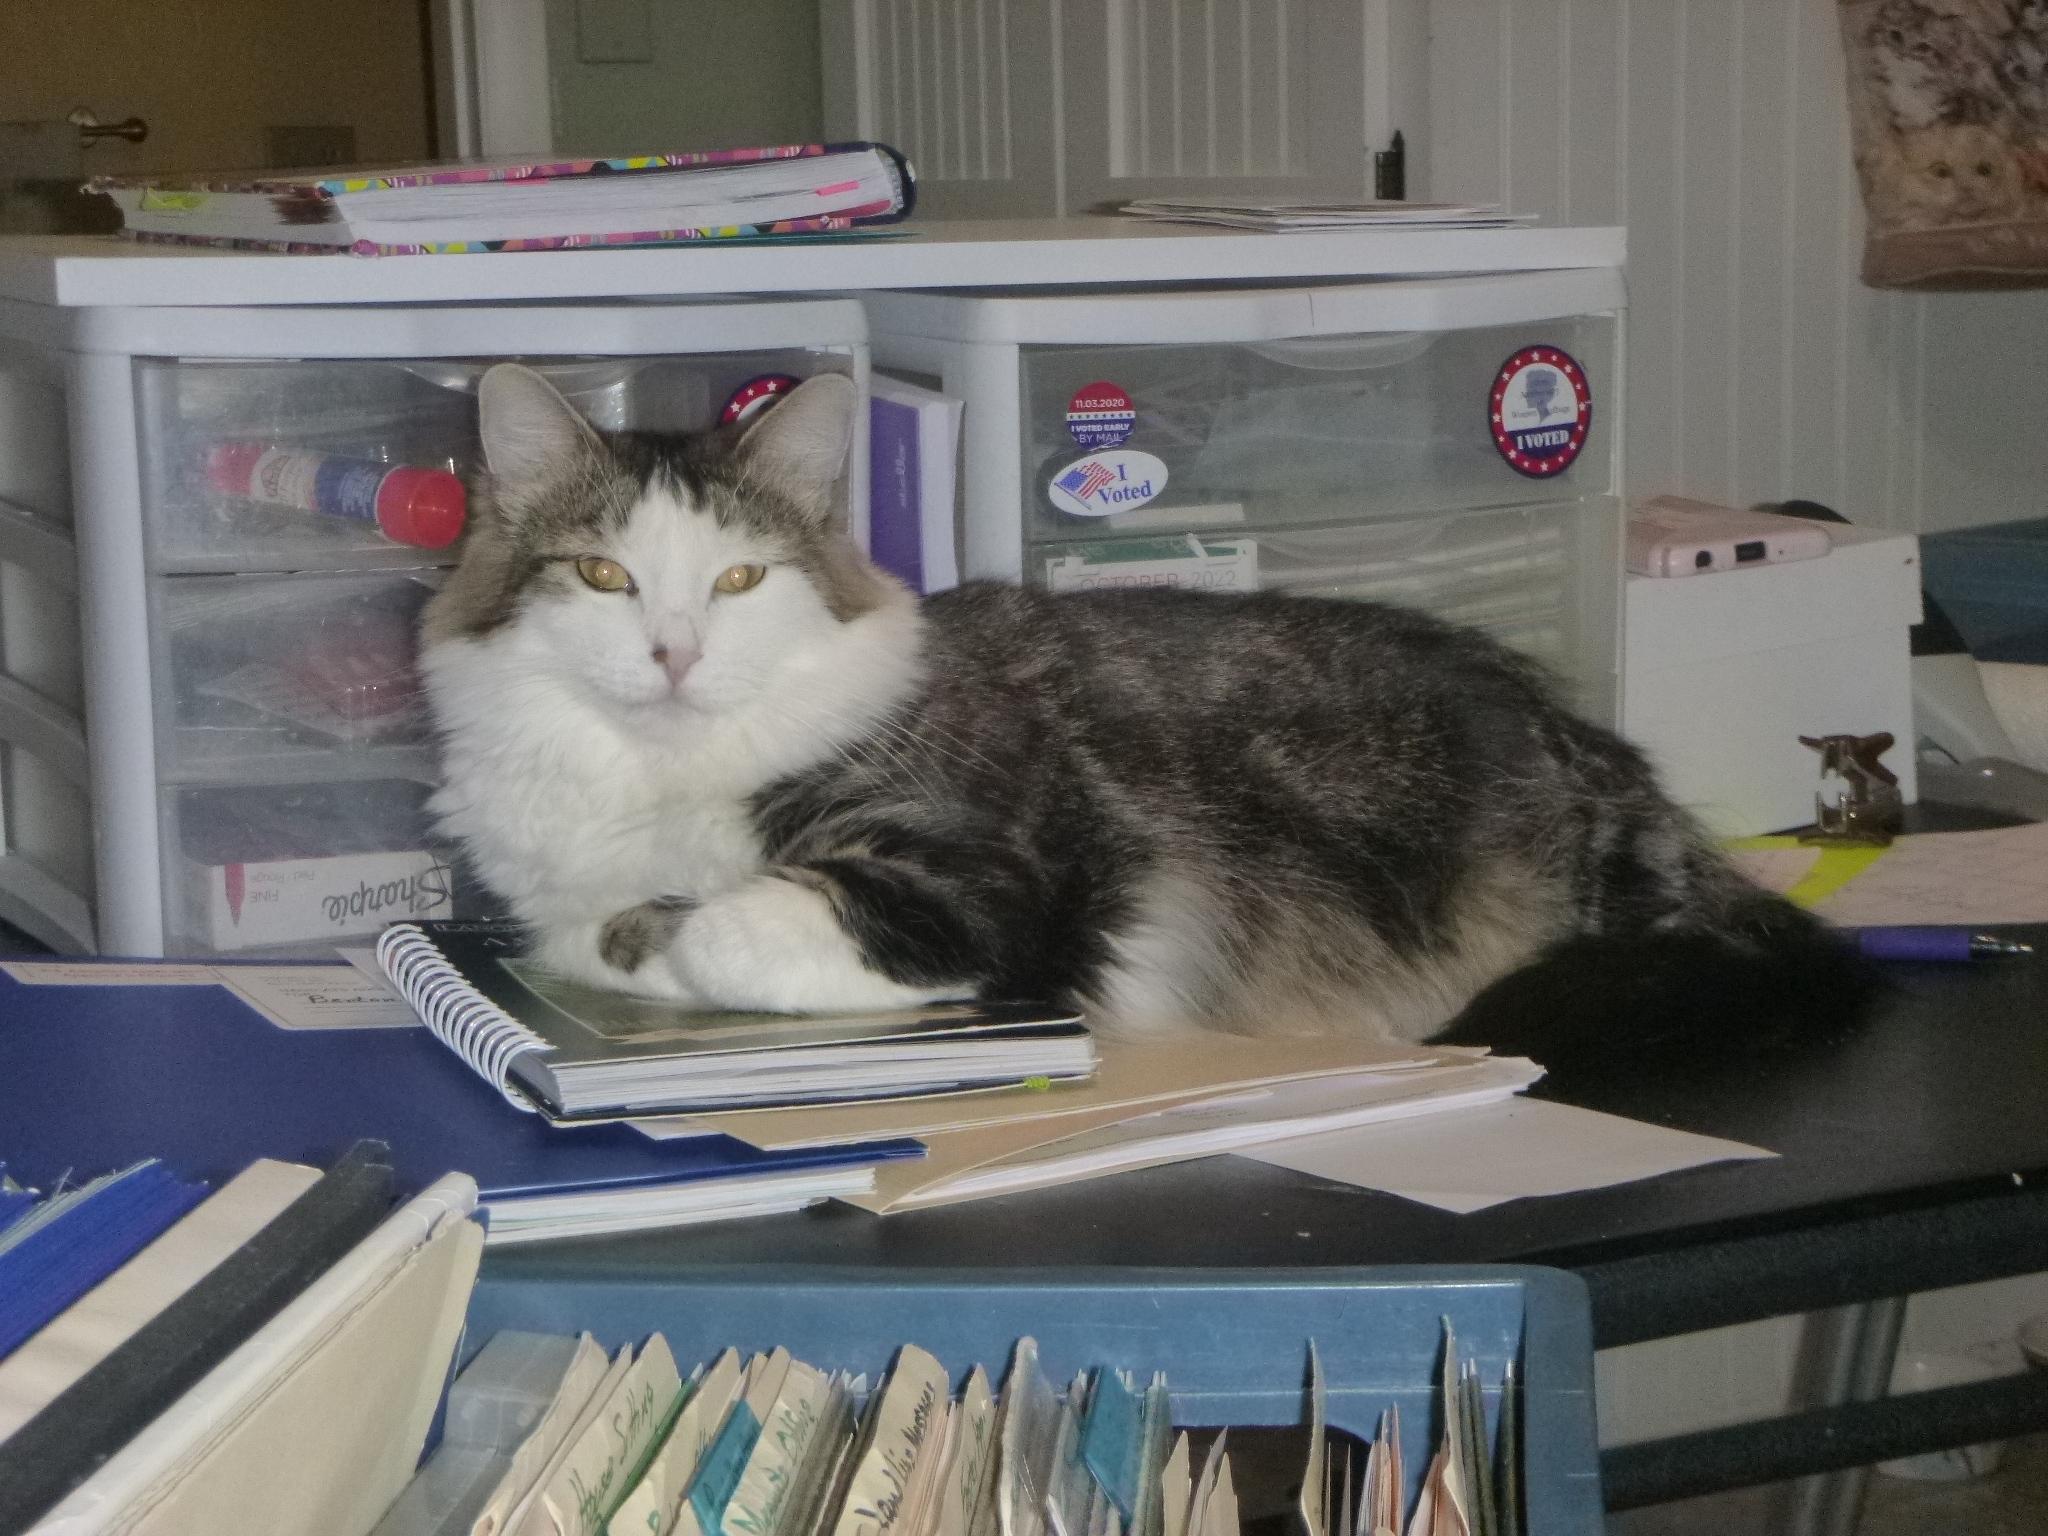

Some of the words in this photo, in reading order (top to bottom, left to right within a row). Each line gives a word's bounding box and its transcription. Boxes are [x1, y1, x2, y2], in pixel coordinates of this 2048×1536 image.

[1075, 399, 1125, 409] 11.03.2020
[1077, 424, 1103, 433] VOTED
[1104, 423, 1130, 432] EARLY
[1080, 434, 1093, 443] BY
[1096, 433, 1121, 442] MAIL
[1517, 435, 1524, 450] I
[1525, 430, 1569, 449] VOTED
[1117, 463, 1127, 482] I
[1098, 480, 1152, 505] Voted
[250, 889, 279, 904] FINE
[321, 865, 452, 926] Sharpie
